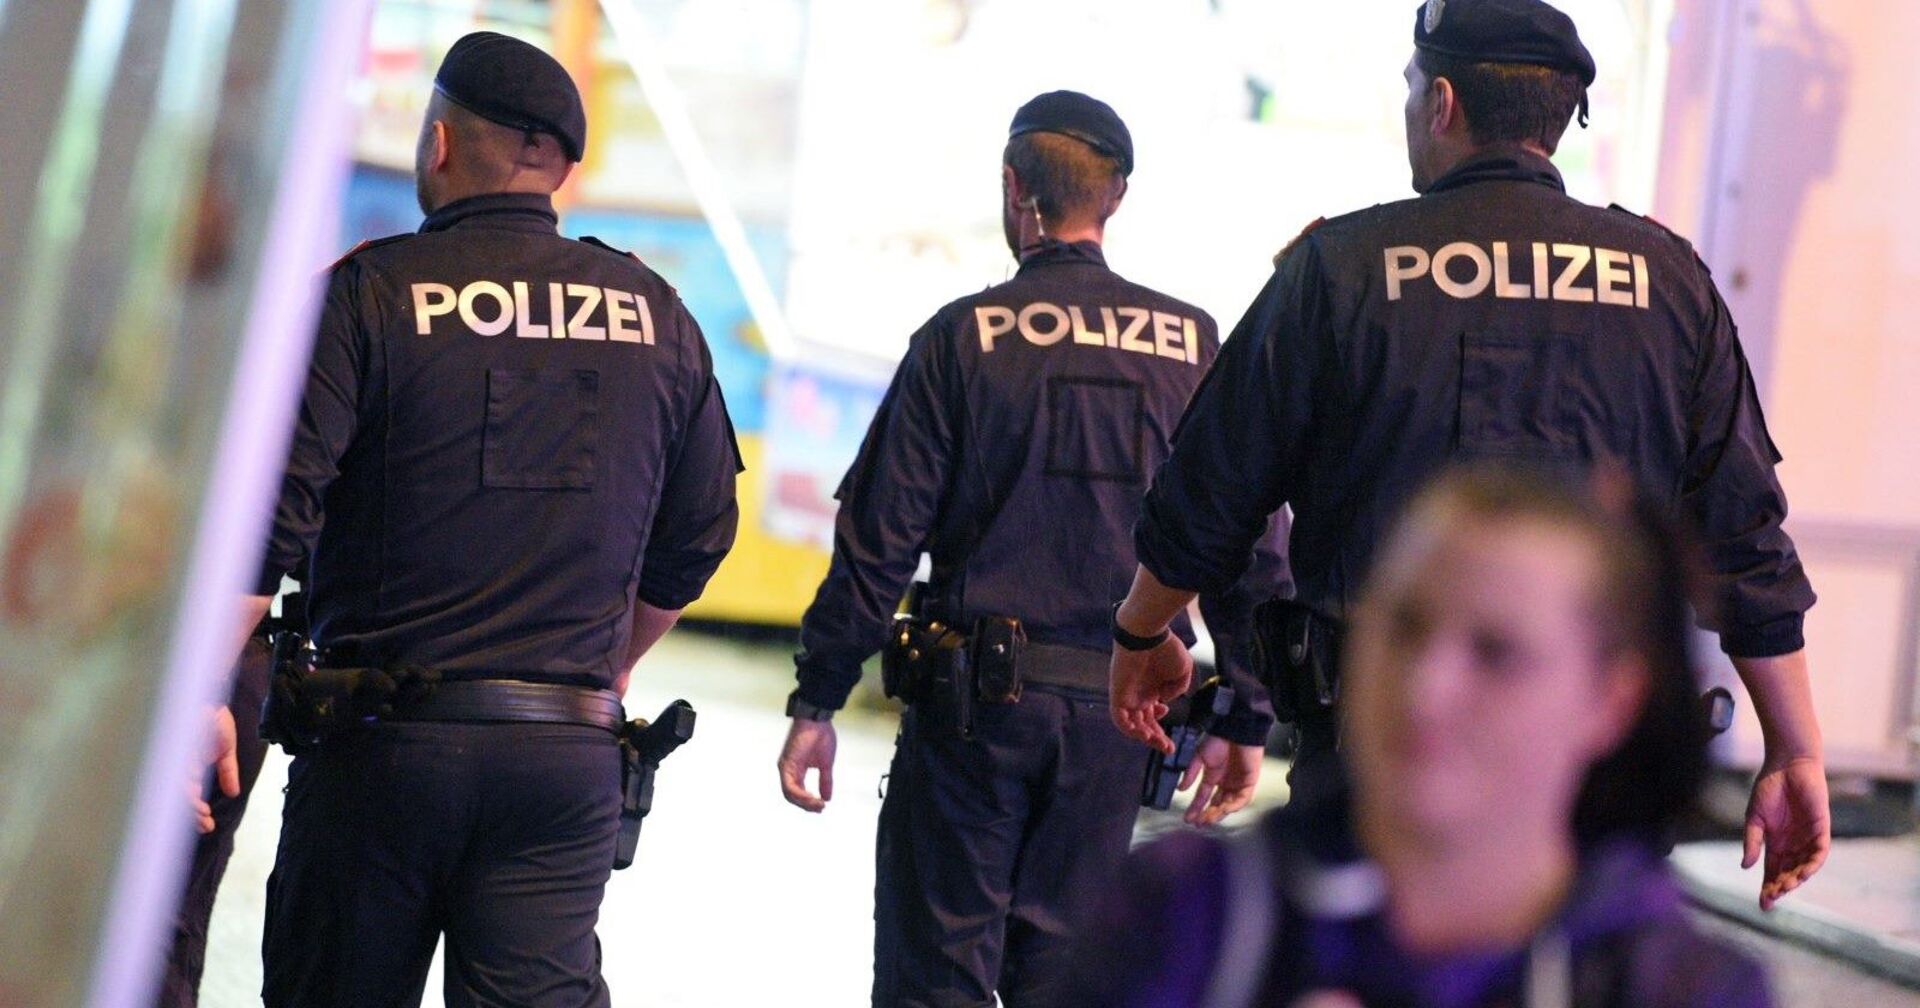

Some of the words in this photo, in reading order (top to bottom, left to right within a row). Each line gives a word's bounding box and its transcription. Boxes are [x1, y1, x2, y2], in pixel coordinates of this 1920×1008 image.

[1384, 241, 1651, 308] POLIZEI
[412, 281, 656, 346] POLIZEI
[975, 303, 1198, 365] POLIZEI
